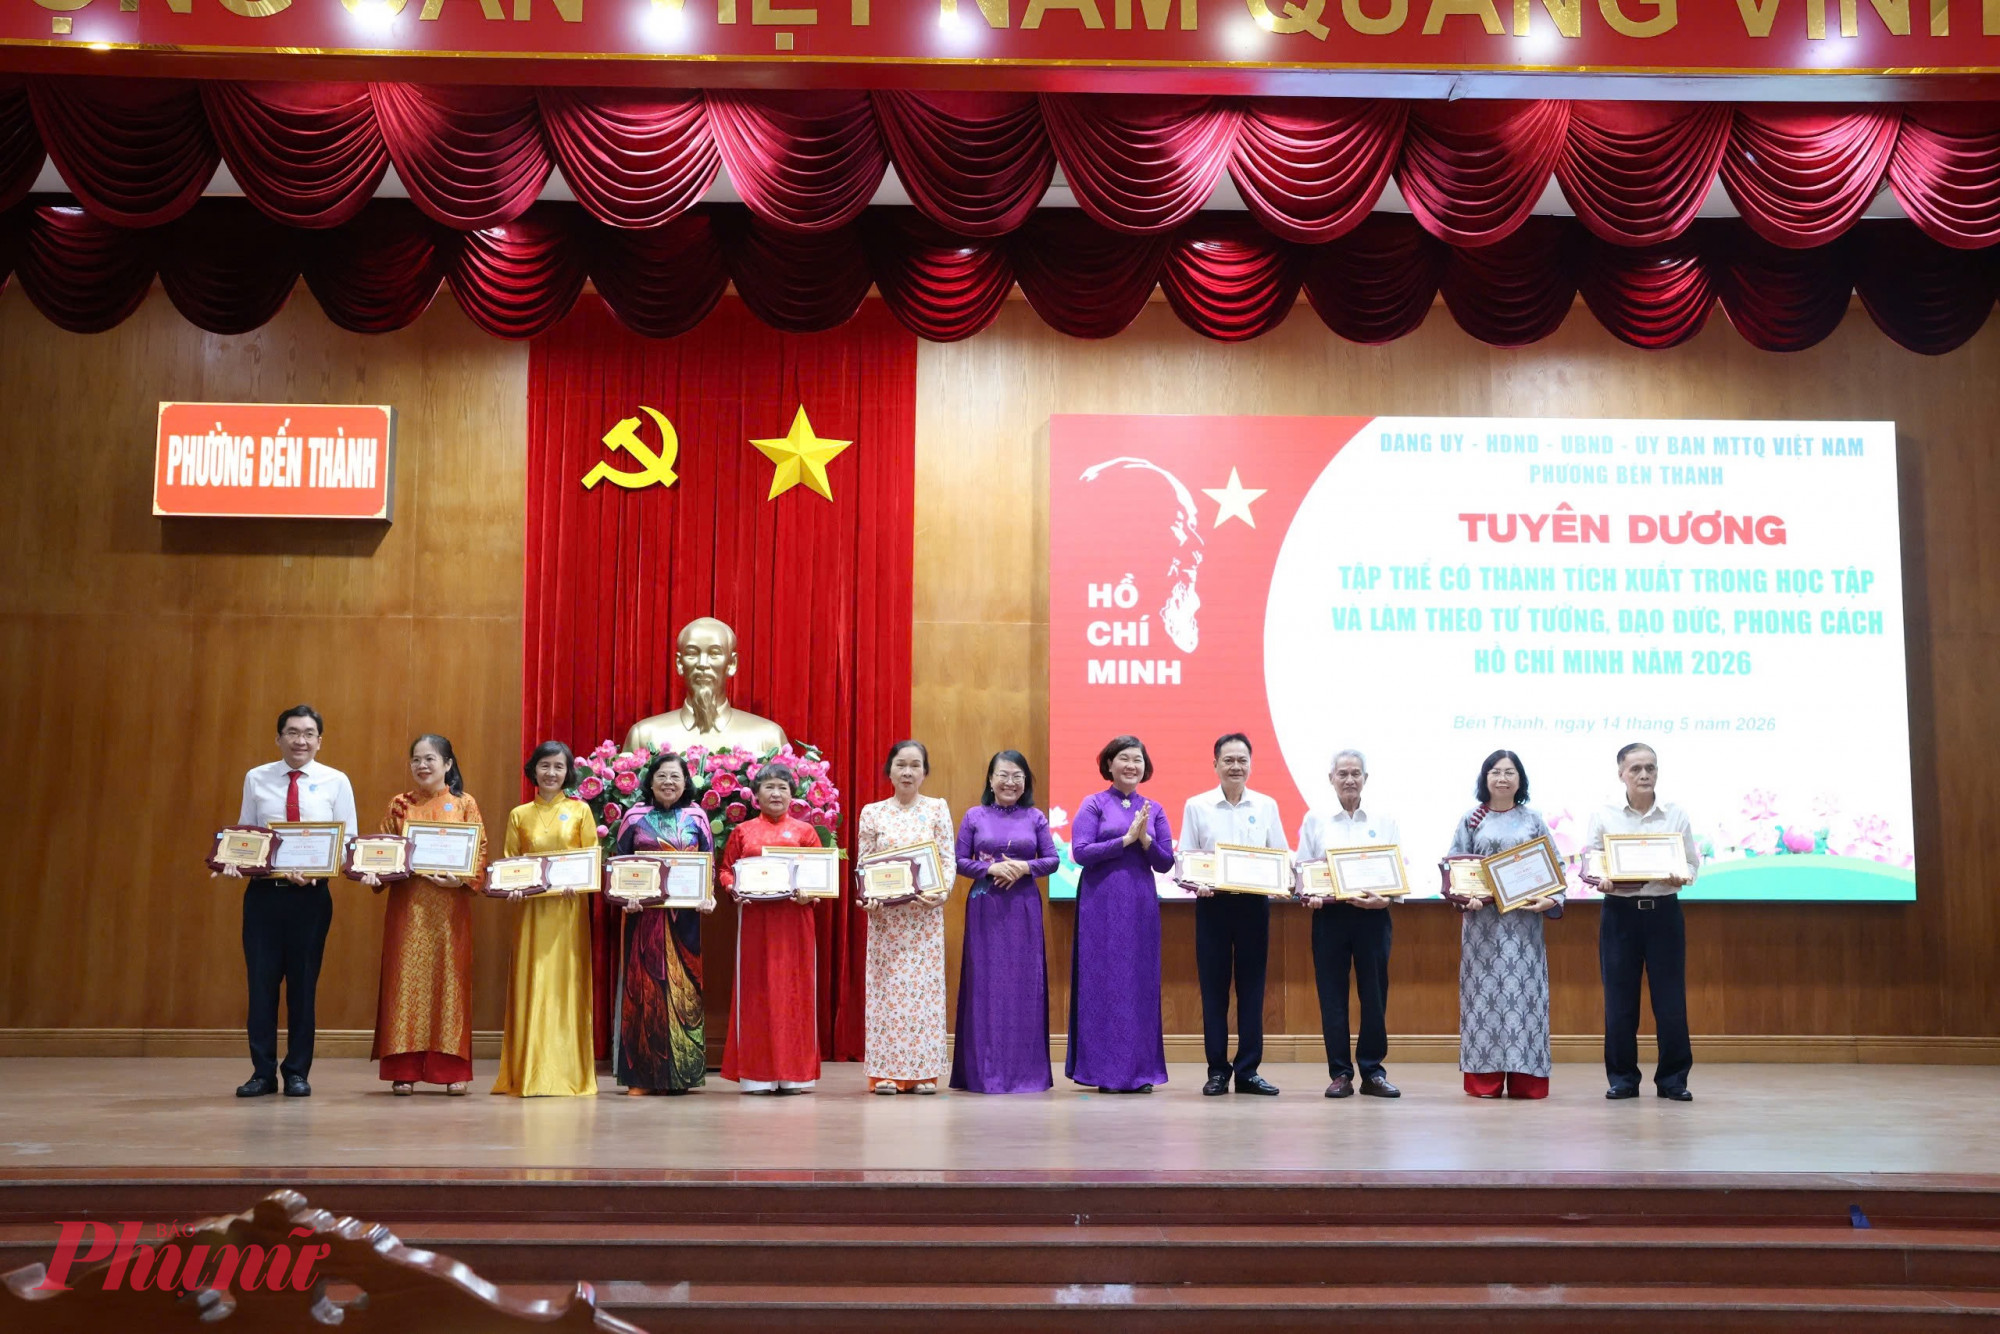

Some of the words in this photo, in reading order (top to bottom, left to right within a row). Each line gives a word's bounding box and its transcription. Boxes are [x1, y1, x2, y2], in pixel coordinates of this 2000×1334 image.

[166, 421, 254, 487] PHƯỜNG
[258, 418, 303, 488] BẾN
[308, 426, 378, 489] THÀNH
[1560, 435, 1614, 455] UBND
[1667, 436, 1706, 456] BAN
[1713, 436, 1765, 458] MTTQ
[1822, 437, 1865, 457] NAM
[1458, 501, 1610, 543] TUYÊN
[1628, 510, 1786, 546] DƯƠNG
[1088, 573, 1139, 609] HỒ
[1338, 561, 1382, 594] TẬP
[1563, 564, 1617, 593] TÍCH
[1690, 567, 1768, 594] TRONG
[1776, 568, 1824, 598] HỌC
[1831, 565, 1875, 599] TẬP
[1087, 614, 1150, 647] CHÍ
[1425, 607, 1482, 632] THEO
[1490, 604, 1522, 632] TƯ
[1734, 609, 1812, 635] PHONG
[1820, 606, 1884, 635] CÁCH
[1088, 659, 1182, 685] MINH
[1563, 649, 1624, 675] MINH
[1691, 650, 1752, 675] 2026
[1602, 716, 1620, 730] 14
[1679, 716, 1690, 731] 5
[1735, 716, 1776, 732] 2026
